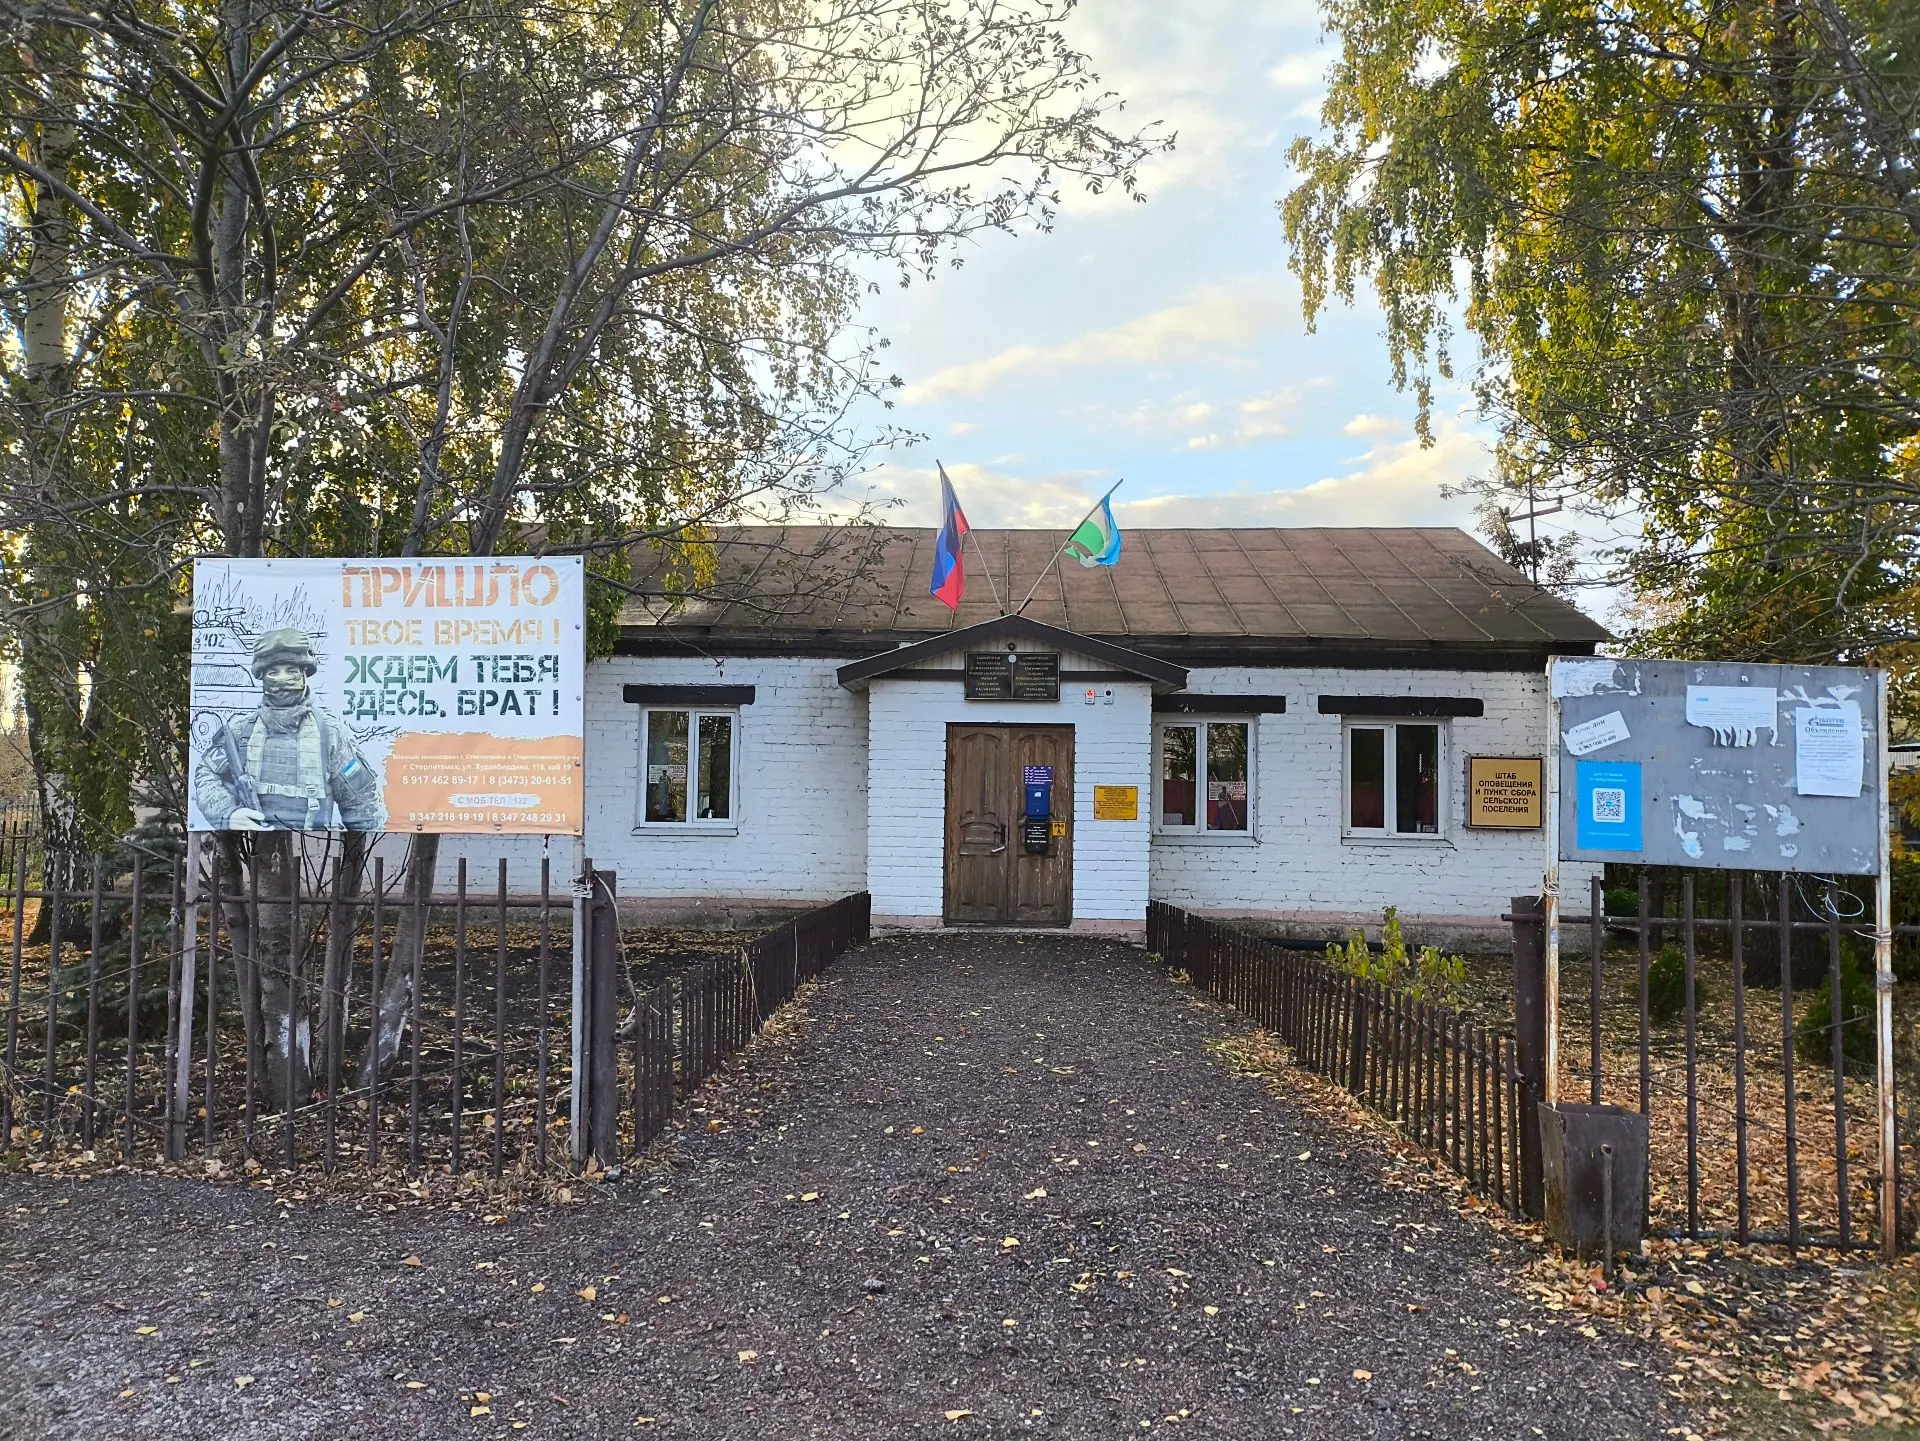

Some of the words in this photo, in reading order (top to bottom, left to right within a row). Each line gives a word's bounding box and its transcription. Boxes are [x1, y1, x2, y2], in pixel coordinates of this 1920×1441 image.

[342, 565, 560, 608] ПРИШЛО
[344, 618, 422, 646] ТВОЕ
[434, 618, 542, 646] ВРЕМЯ
[344, 654, 458, 690] ЖДЕМ
[470, 654, 560, 684] ТЕБЯ
[342, 690, 447, 722] ЗДЕСЬ,
[456, 690, 542, 716] БРАТ
[402, 776, 408, 785] 8
[410, 776, 429, 785] 917
[432, 776, 449, 785] 462
[451, 776, 478, 785] 89-17
[489, 776, 495, 785] 8
[498, 775, 528, 786] (3473)
[530, 776, 572, 785] 20-61-51
[1478, 780, 1532, 788] ОПОВЕЩЕНИЯ
[409, 812, 416, 822] 8
[417, 812, 434, 822] 347
[438, 812, 455, 822] 218
[458, 812, 469, 822] 19
[472, 812, 484, 822] 19
[492, 813, 498, 822] 8
[500, 813, 518, 822] 347
[520, 813, 538, 822] 248
[541, 813, 552, 822] 29
[554, 813, 566, 822] 31
